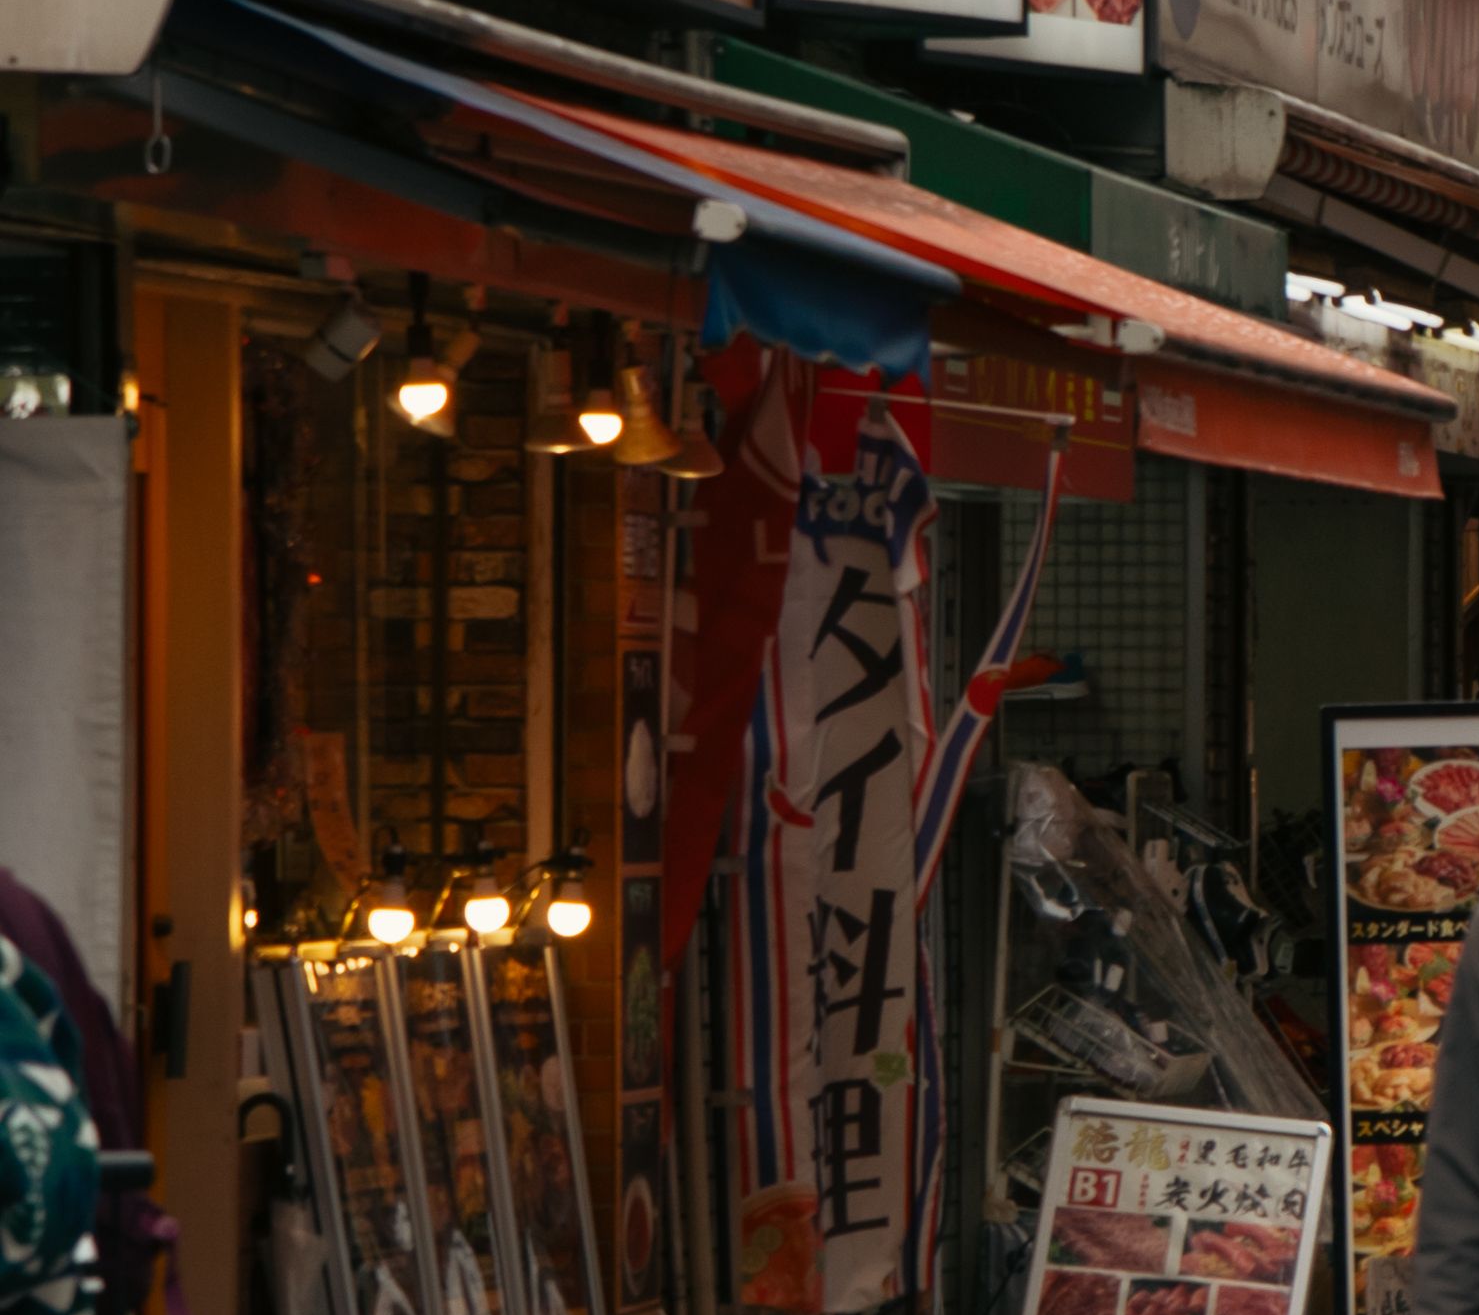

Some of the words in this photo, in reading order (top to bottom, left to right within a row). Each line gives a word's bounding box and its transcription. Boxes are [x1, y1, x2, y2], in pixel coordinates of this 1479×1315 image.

[808, 563, 906, 1241] タイ料理
[1351, 919, 1470, 939] スタンダード食べ
[1356, 1119, 1425, 1139] スペシャ
[1071, 1169, 1119, 1207] B1
